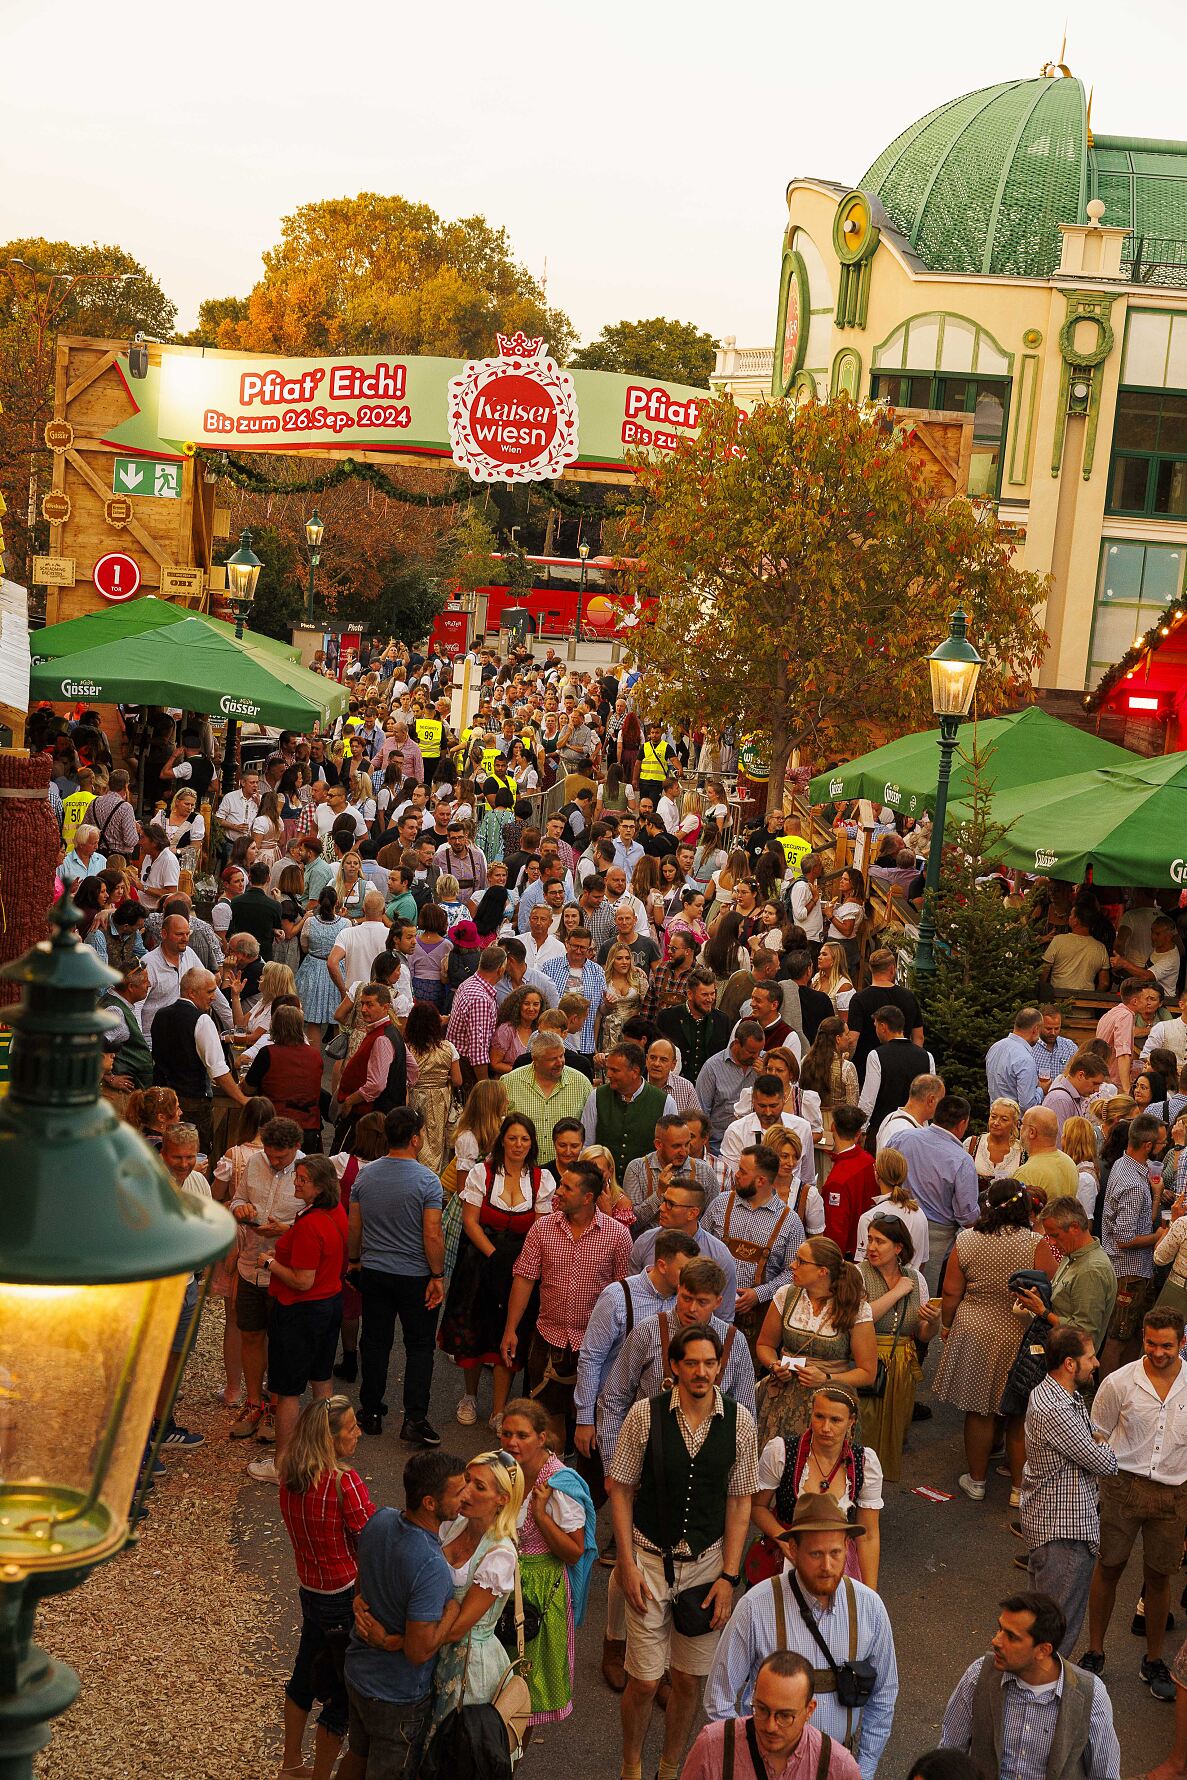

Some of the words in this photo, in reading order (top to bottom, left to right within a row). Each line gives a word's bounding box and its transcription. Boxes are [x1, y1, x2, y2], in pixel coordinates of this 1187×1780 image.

[332, 367, 404, 397] Eich!
[475, 396, 557, 424] Kaiser
[628, 389, 700, 426] Pfiat
[206, 412, 231, 430] Bis
[239, 416, 277, 431] zum
[284, 411, 353, 432] 26.Sep.
[359, 408, 409, 426] 2024
[475, 421, 547, 446] wiesn
[624, 424, 649, 443] Bis
[500, 444, 522, 454] Wien
[113, 564, 121, 585] 1
[347, 623, 364, 632] Photo
[61, 679, 102, 698] Gösser
[219, 695, 261, 716] Gösser
[424, 731, 434, 741] 99
[782, 843, 809, 853] SECURITY
[787, 851, 798, 865] 95
